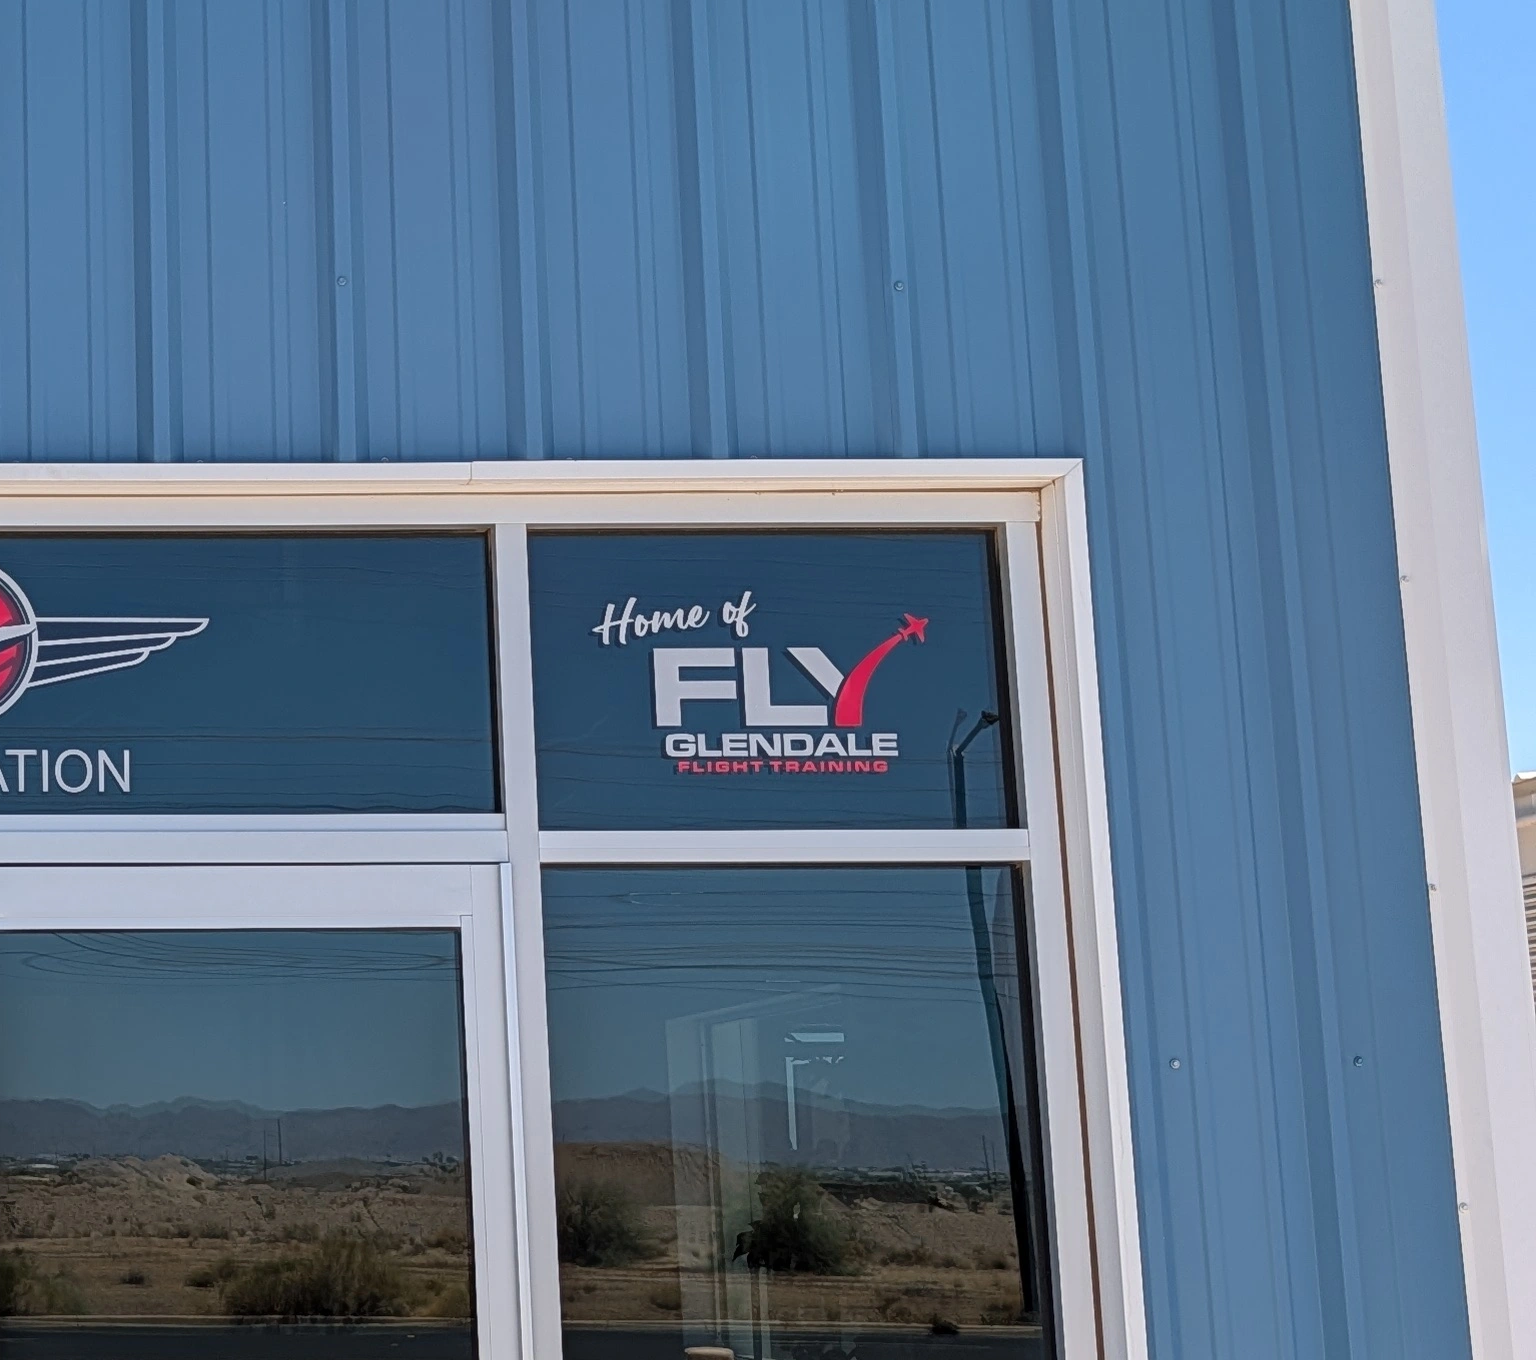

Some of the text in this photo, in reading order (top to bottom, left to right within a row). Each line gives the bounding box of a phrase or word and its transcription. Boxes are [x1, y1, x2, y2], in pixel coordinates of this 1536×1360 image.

[592, 590, 757, 645] Home of
[652, 636, 902, 728] FLY
[665, 732, 899, 758] GLENDALE
[677, 760, 889, 774] FLIGHT TRAINING
